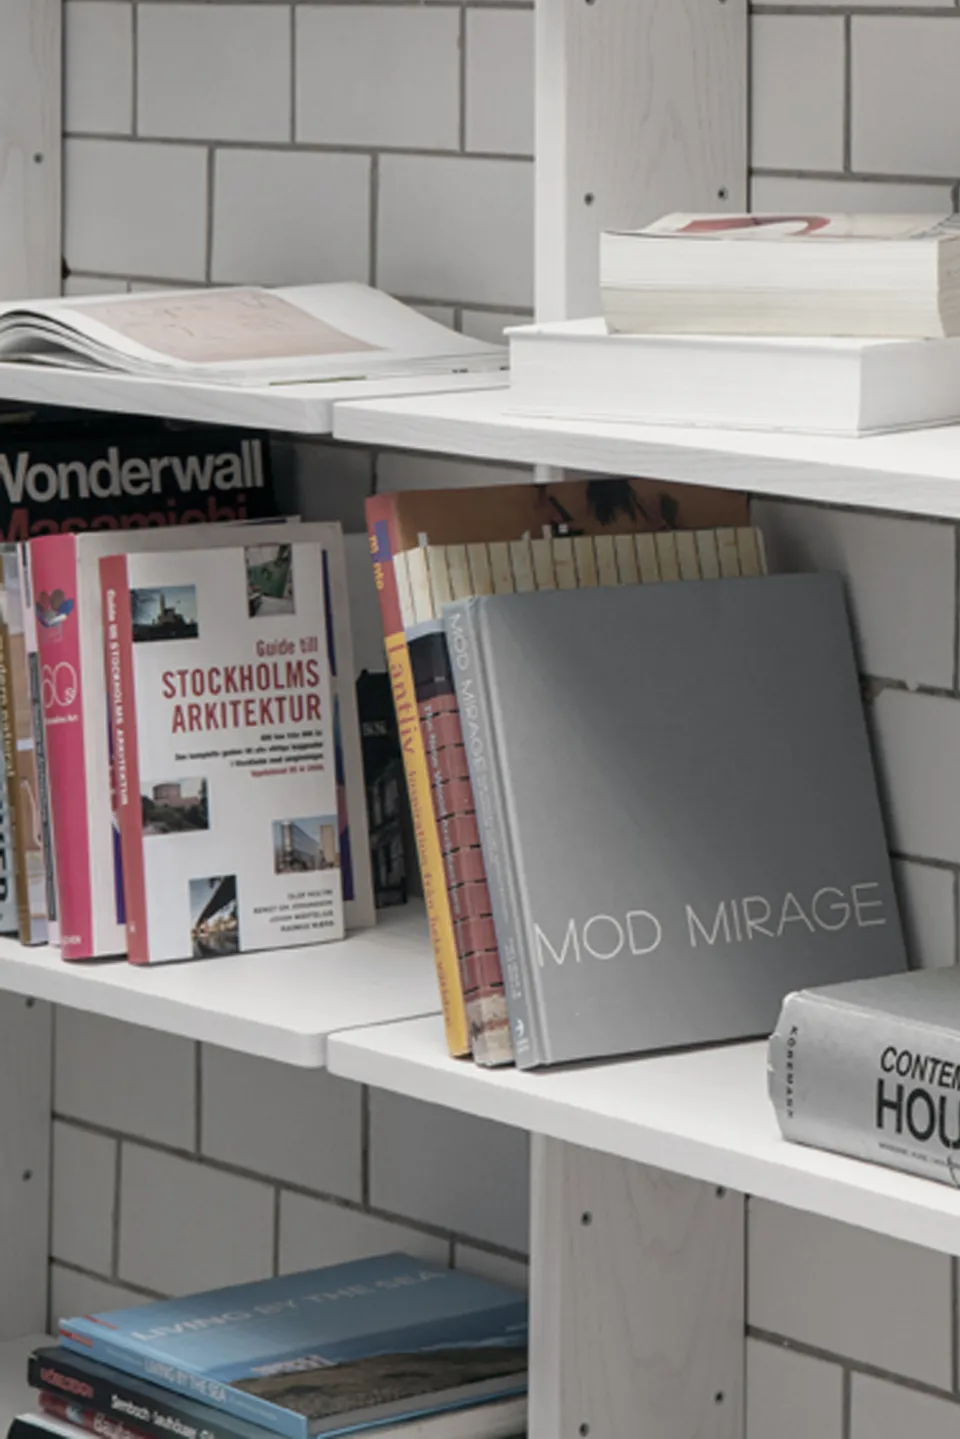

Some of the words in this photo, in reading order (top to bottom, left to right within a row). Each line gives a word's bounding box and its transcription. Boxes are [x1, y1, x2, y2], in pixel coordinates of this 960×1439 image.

[256, 638, 296, 657] Guide
[300, 636, 318, 653] till
[111, 641, 125, 724] STOCKHOLMS
[162, 659, 320, 699] STOCKHOLMS
[449, 612, 469, 669] MOD
[460, 677, 483, 772] MIRAGE
[172, 693, 321, 733] ARKITEKTUR
[533, 908, 661, 968] MOD
[686, 881, 887, 950] MIRAGE
[131, 1311, 252, 1341] LIVING
